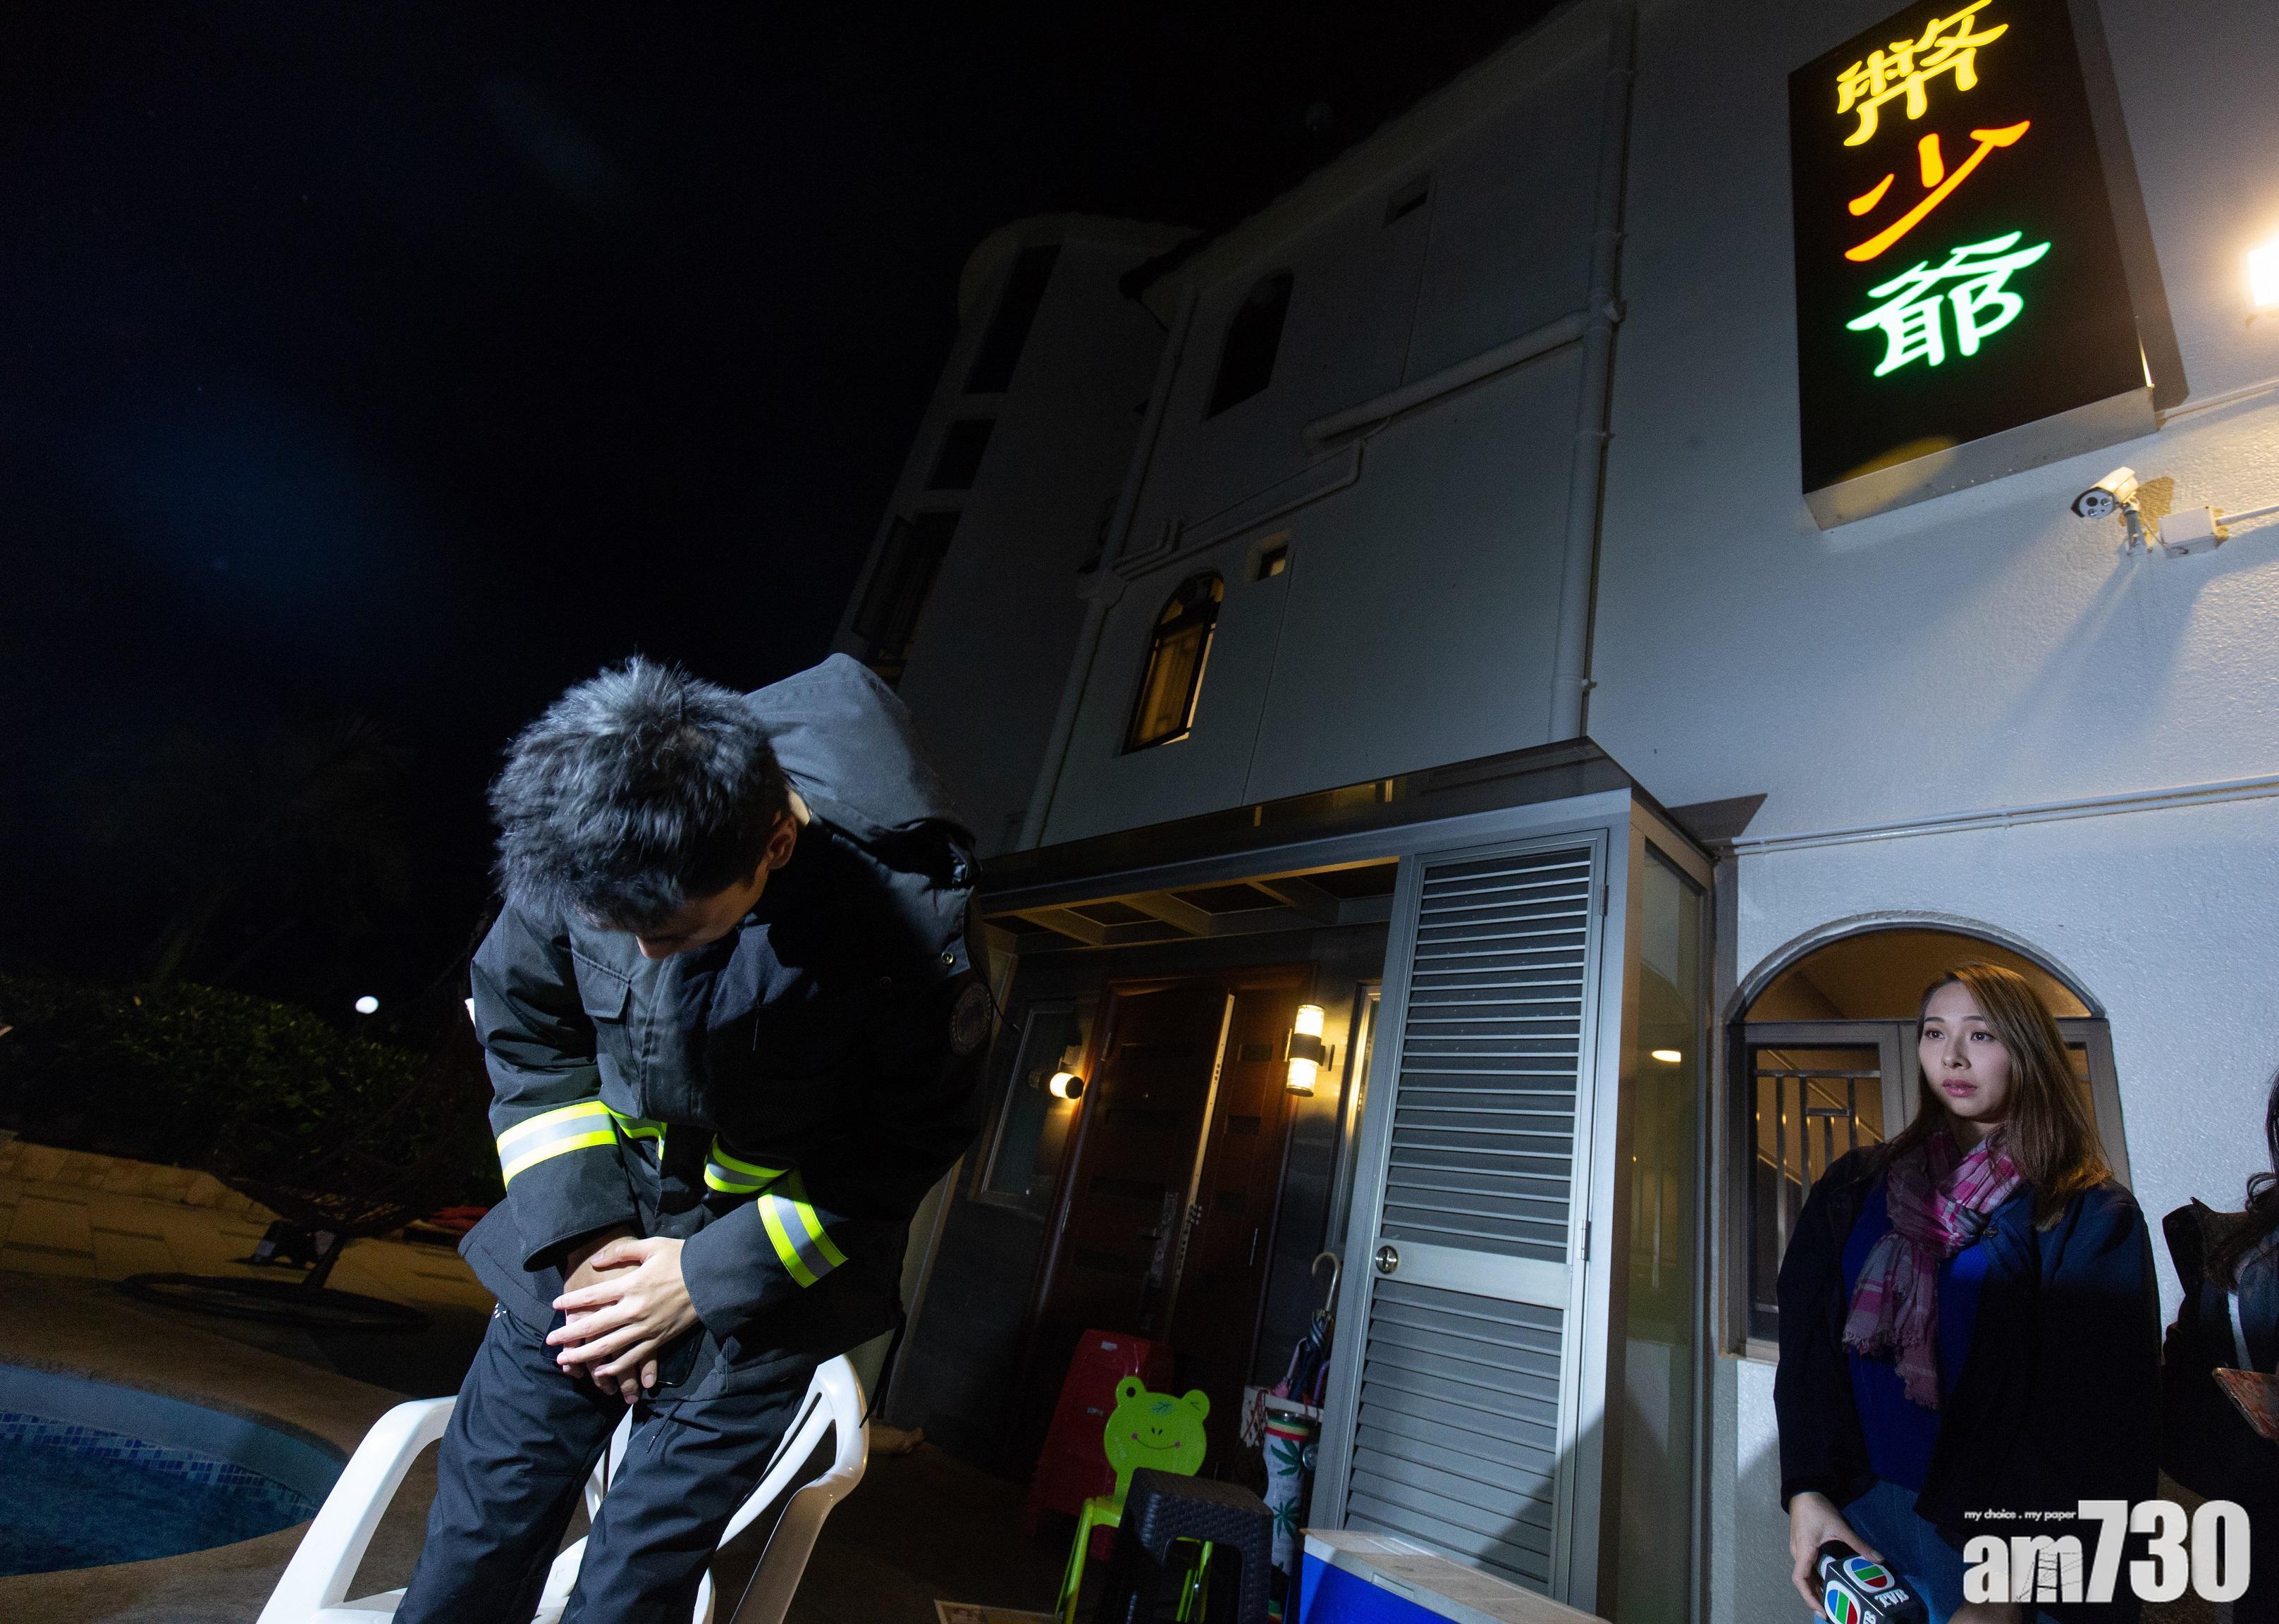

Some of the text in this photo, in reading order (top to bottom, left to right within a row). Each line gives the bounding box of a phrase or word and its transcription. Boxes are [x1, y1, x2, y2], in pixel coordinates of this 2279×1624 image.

[1837, 0, 2051, 377] 弊少爺
[1874, 1589, 1910, 1608] TVB
